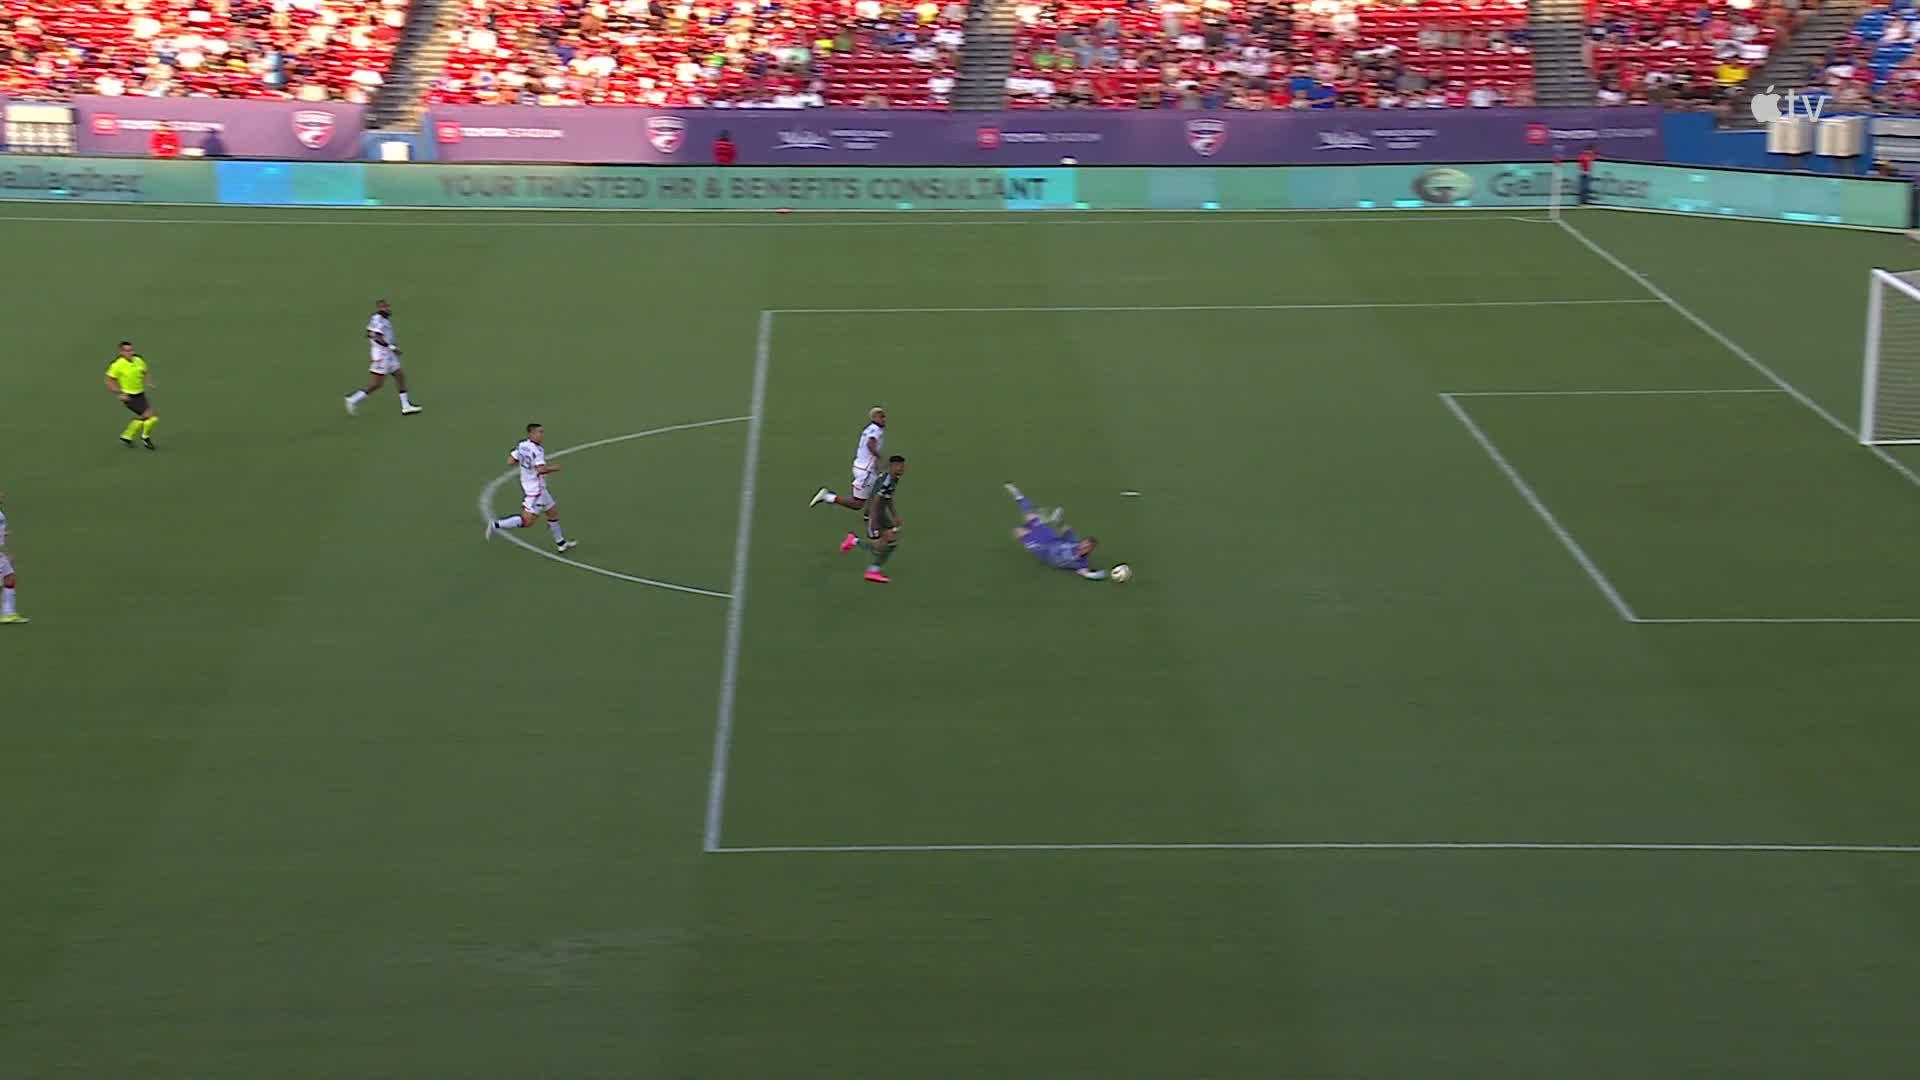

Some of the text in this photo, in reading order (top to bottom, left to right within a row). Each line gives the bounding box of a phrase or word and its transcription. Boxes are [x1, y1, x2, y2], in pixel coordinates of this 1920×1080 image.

[439, 175, 1047, 200] YOUR TRUSTED HR & BENEFITS CONSULTANT
